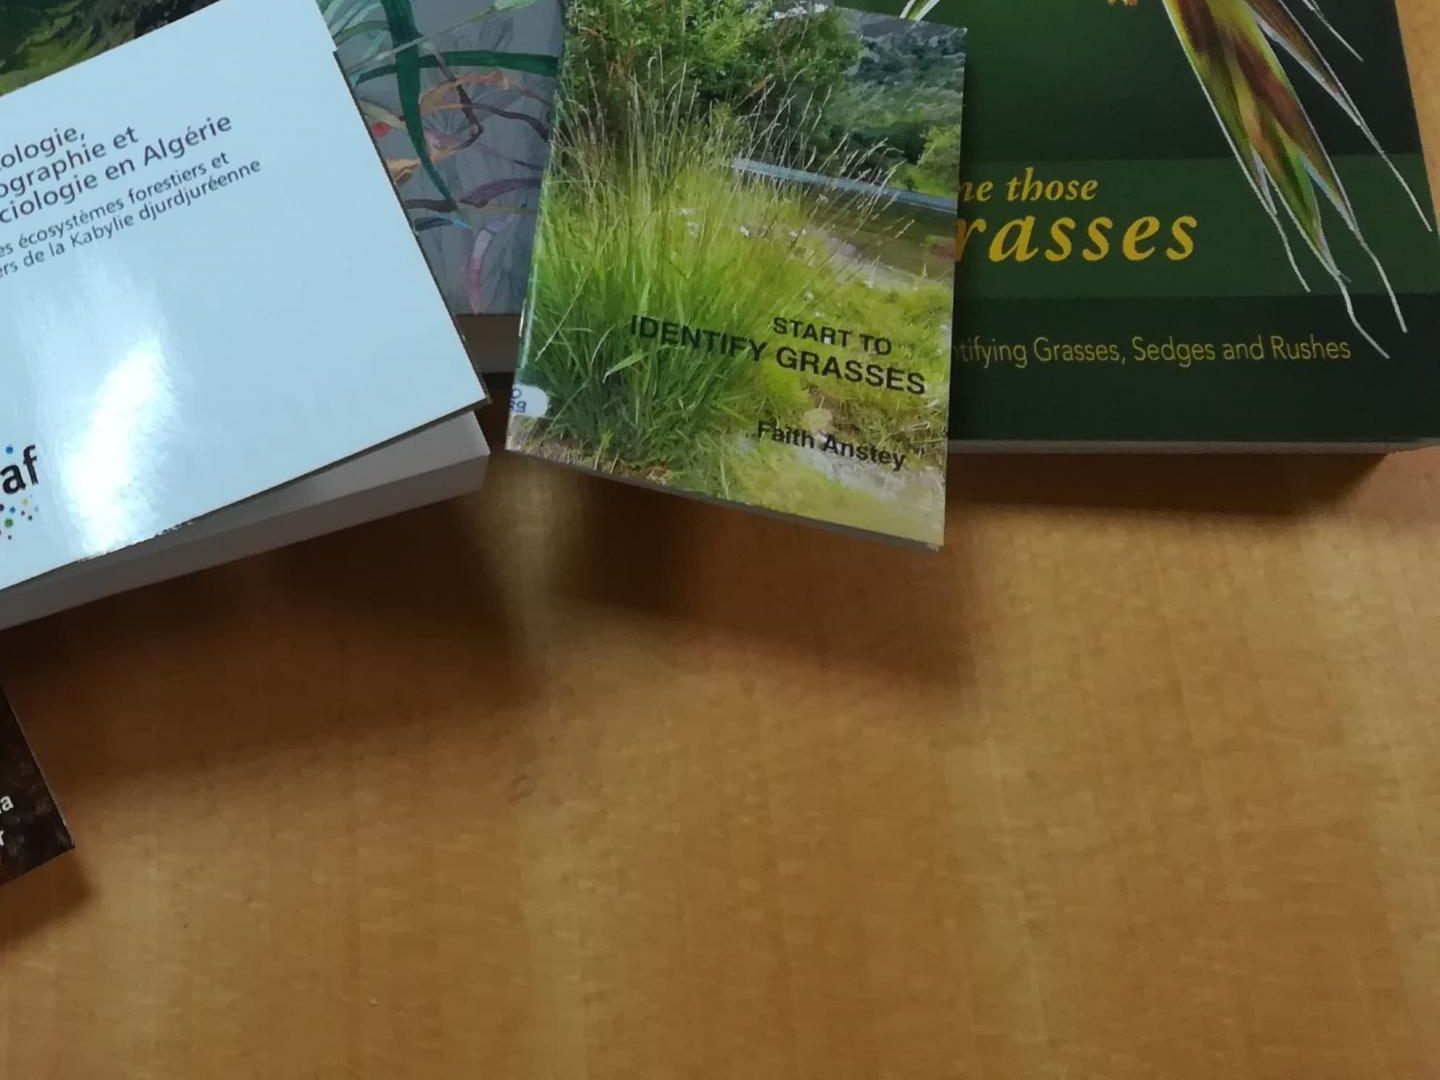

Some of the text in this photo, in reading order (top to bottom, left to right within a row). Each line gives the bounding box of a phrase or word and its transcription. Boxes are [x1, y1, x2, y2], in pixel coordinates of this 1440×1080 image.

[105, 158, 136, 181] en
[143, 115, 233, 167] Algérie
[113, 126, 139, 150] et
[18, 198, 125, 250] écosystèmes
[128, 162, 208, 205] forestiers
[211, 151, 231, 169] et
[1006, 167, 1098, 202] those
[23, 251, 46, 268] de
[49, 242, 66, 258] la
[70, 214, 135, 248] Kabylie
[138, 159, 261, 221] djurdjuréenne
[631, 314, 926, 395] IDENTIFY GRASSES
[772, 317, 892, 355] START TO
[1033, 336, 1126, 366] Grasses,
[1131, 337, 1216, 368] Sedges
[1222, 335, 1264, 360] and
[1270, 333, 1351, 360] Rushes
[757, 421, 906, 471] Faith Anstey
